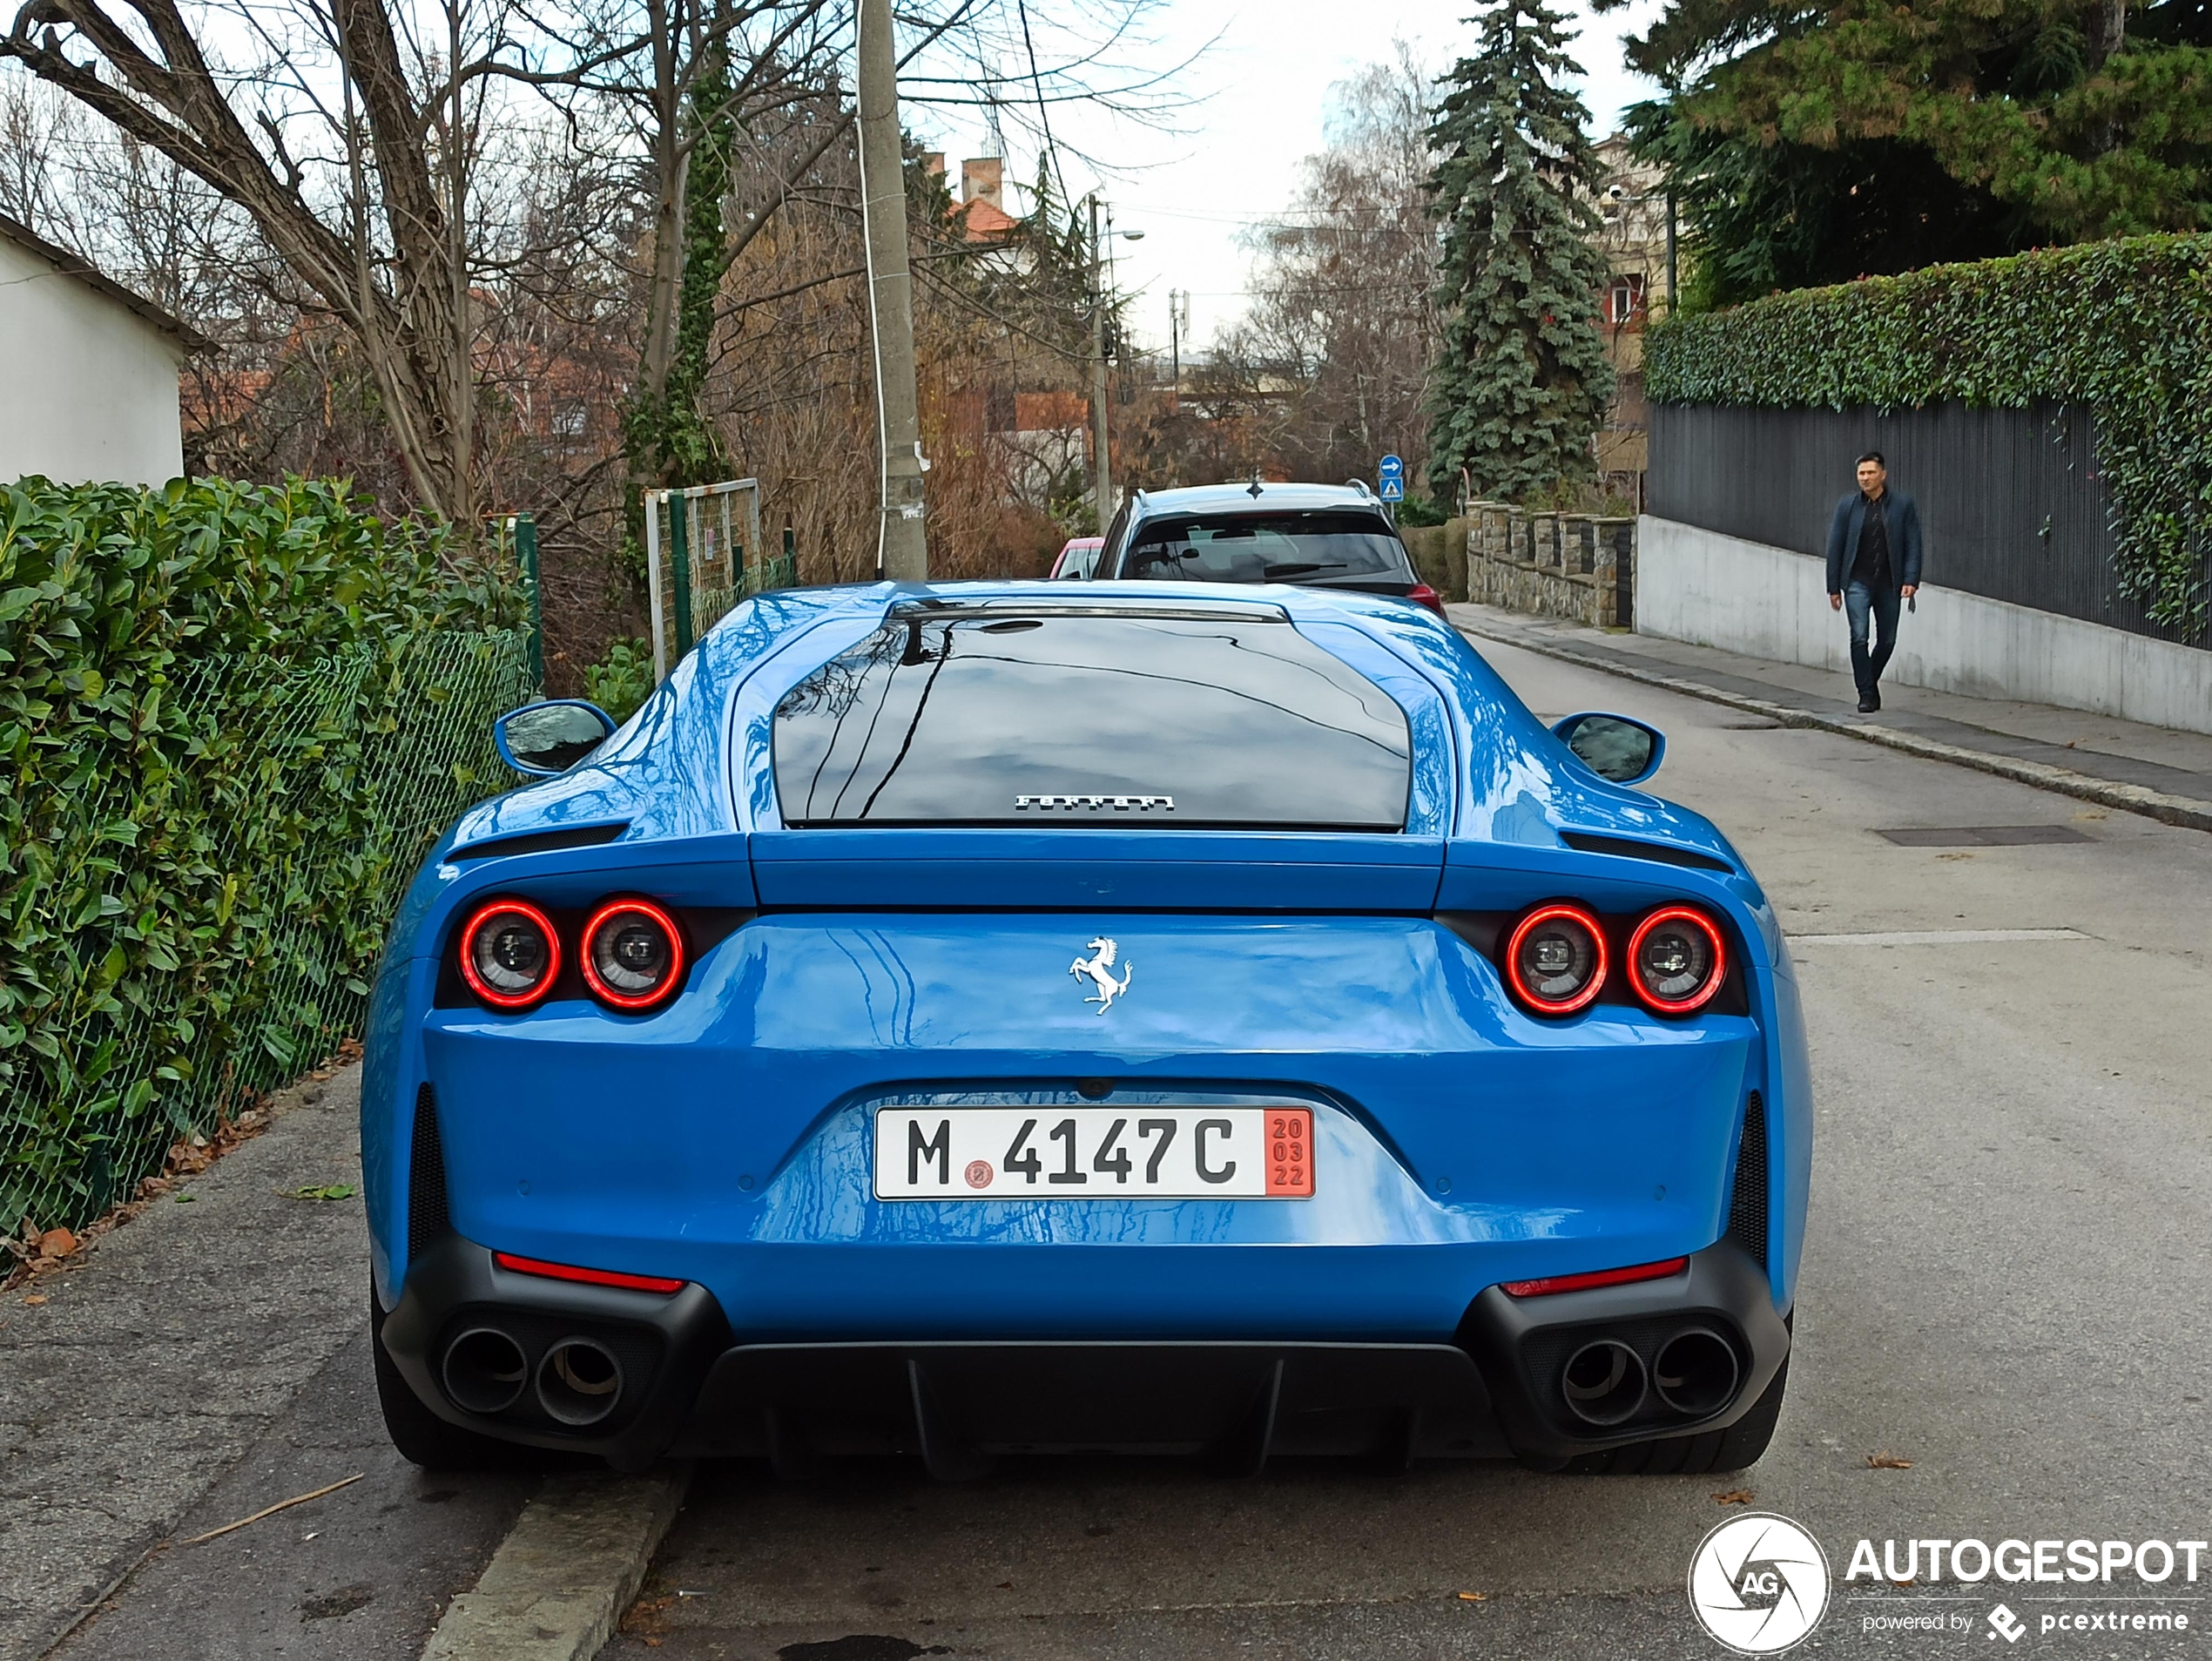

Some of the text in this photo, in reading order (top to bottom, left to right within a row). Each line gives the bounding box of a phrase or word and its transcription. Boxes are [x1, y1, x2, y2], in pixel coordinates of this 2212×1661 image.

[1015, 794, 1175, 809] Ferrari
[1272, 1119, 1303, 1139] 20
[908, 1119, 950, 1185] M
[1003, 1118, 1177, 1185] 4147
[1195, 1119, 1237, 1184] C
[1272, 1142, 1303, 1162] 03
[1273, 1165, 1304, 1185] 22
